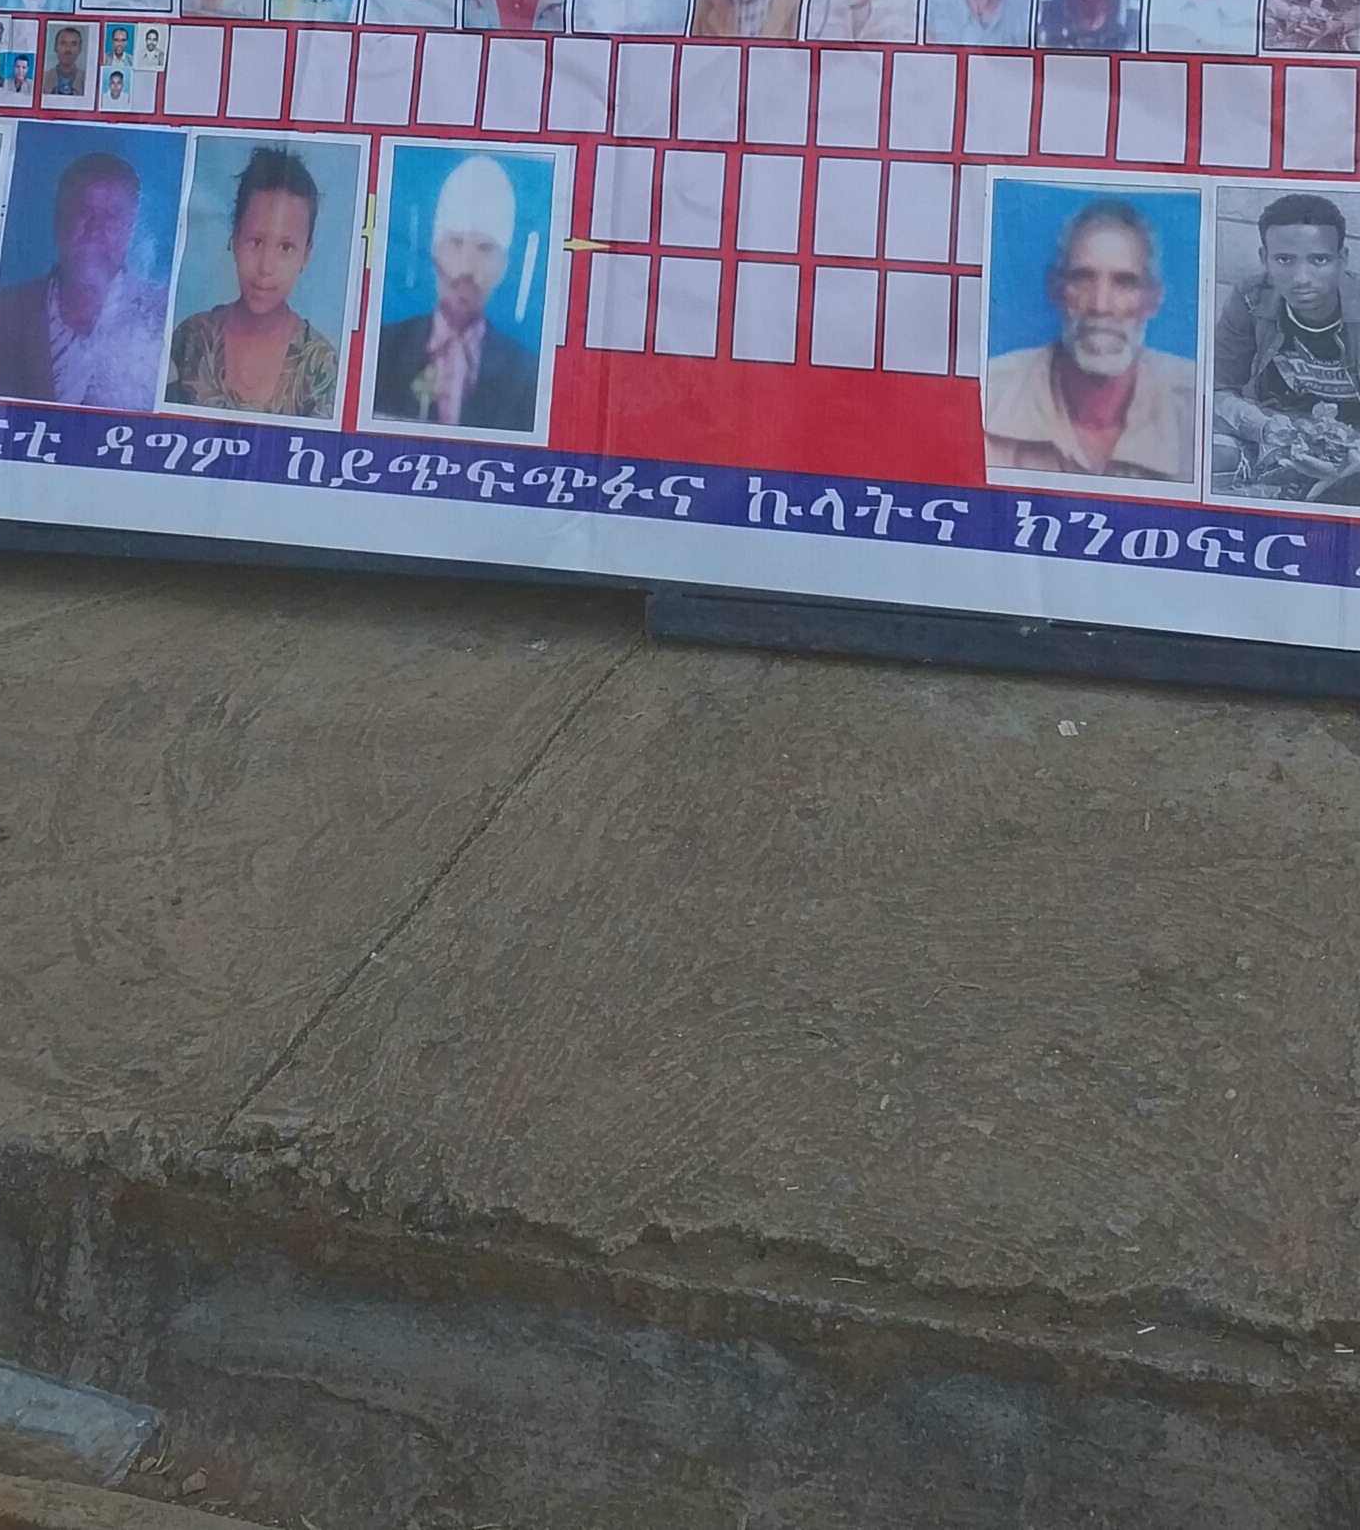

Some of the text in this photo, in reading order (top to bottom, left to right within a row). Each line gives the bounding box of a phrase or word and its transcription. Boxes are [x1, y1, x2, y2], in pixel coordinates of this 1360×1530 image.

[95, 424, 252, 473] ዳግም
[747, 476, 970, 542] ኩላትና
[1013, 500, 1308, 577] ክንወፍር
